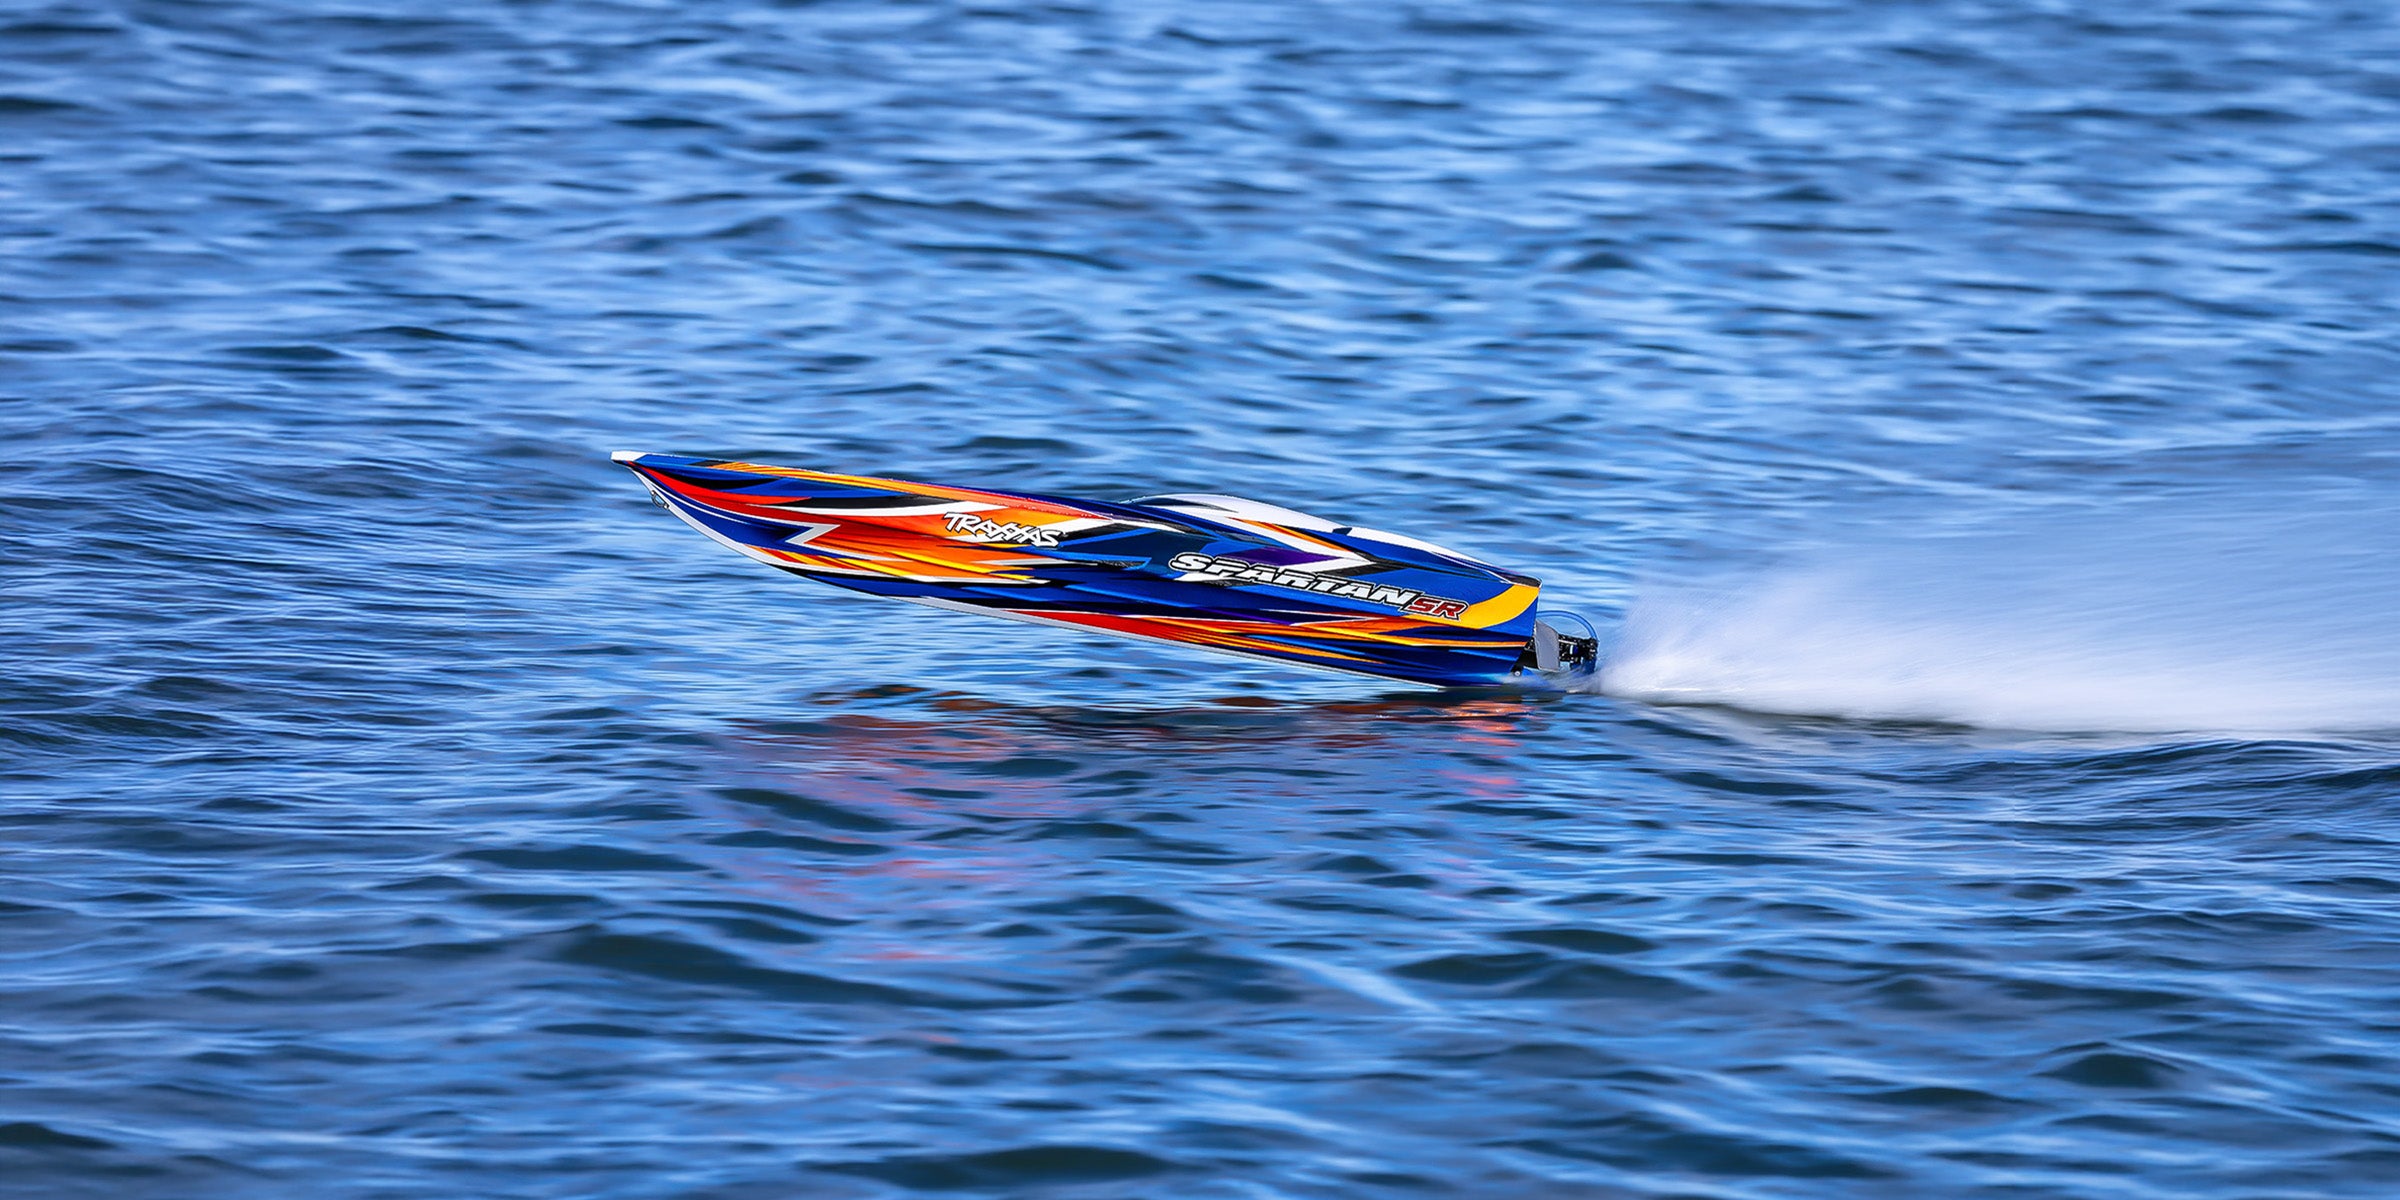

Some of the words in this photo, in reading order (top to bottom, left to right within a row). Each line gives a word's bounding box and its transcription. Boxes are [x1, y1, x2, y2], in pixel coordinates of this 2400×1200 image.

[943, 512, 1061, 547] TRAXXAS
[1169, 552, 1420, 607] SPARTAN
[1404, 596, 1468, 619] SR
